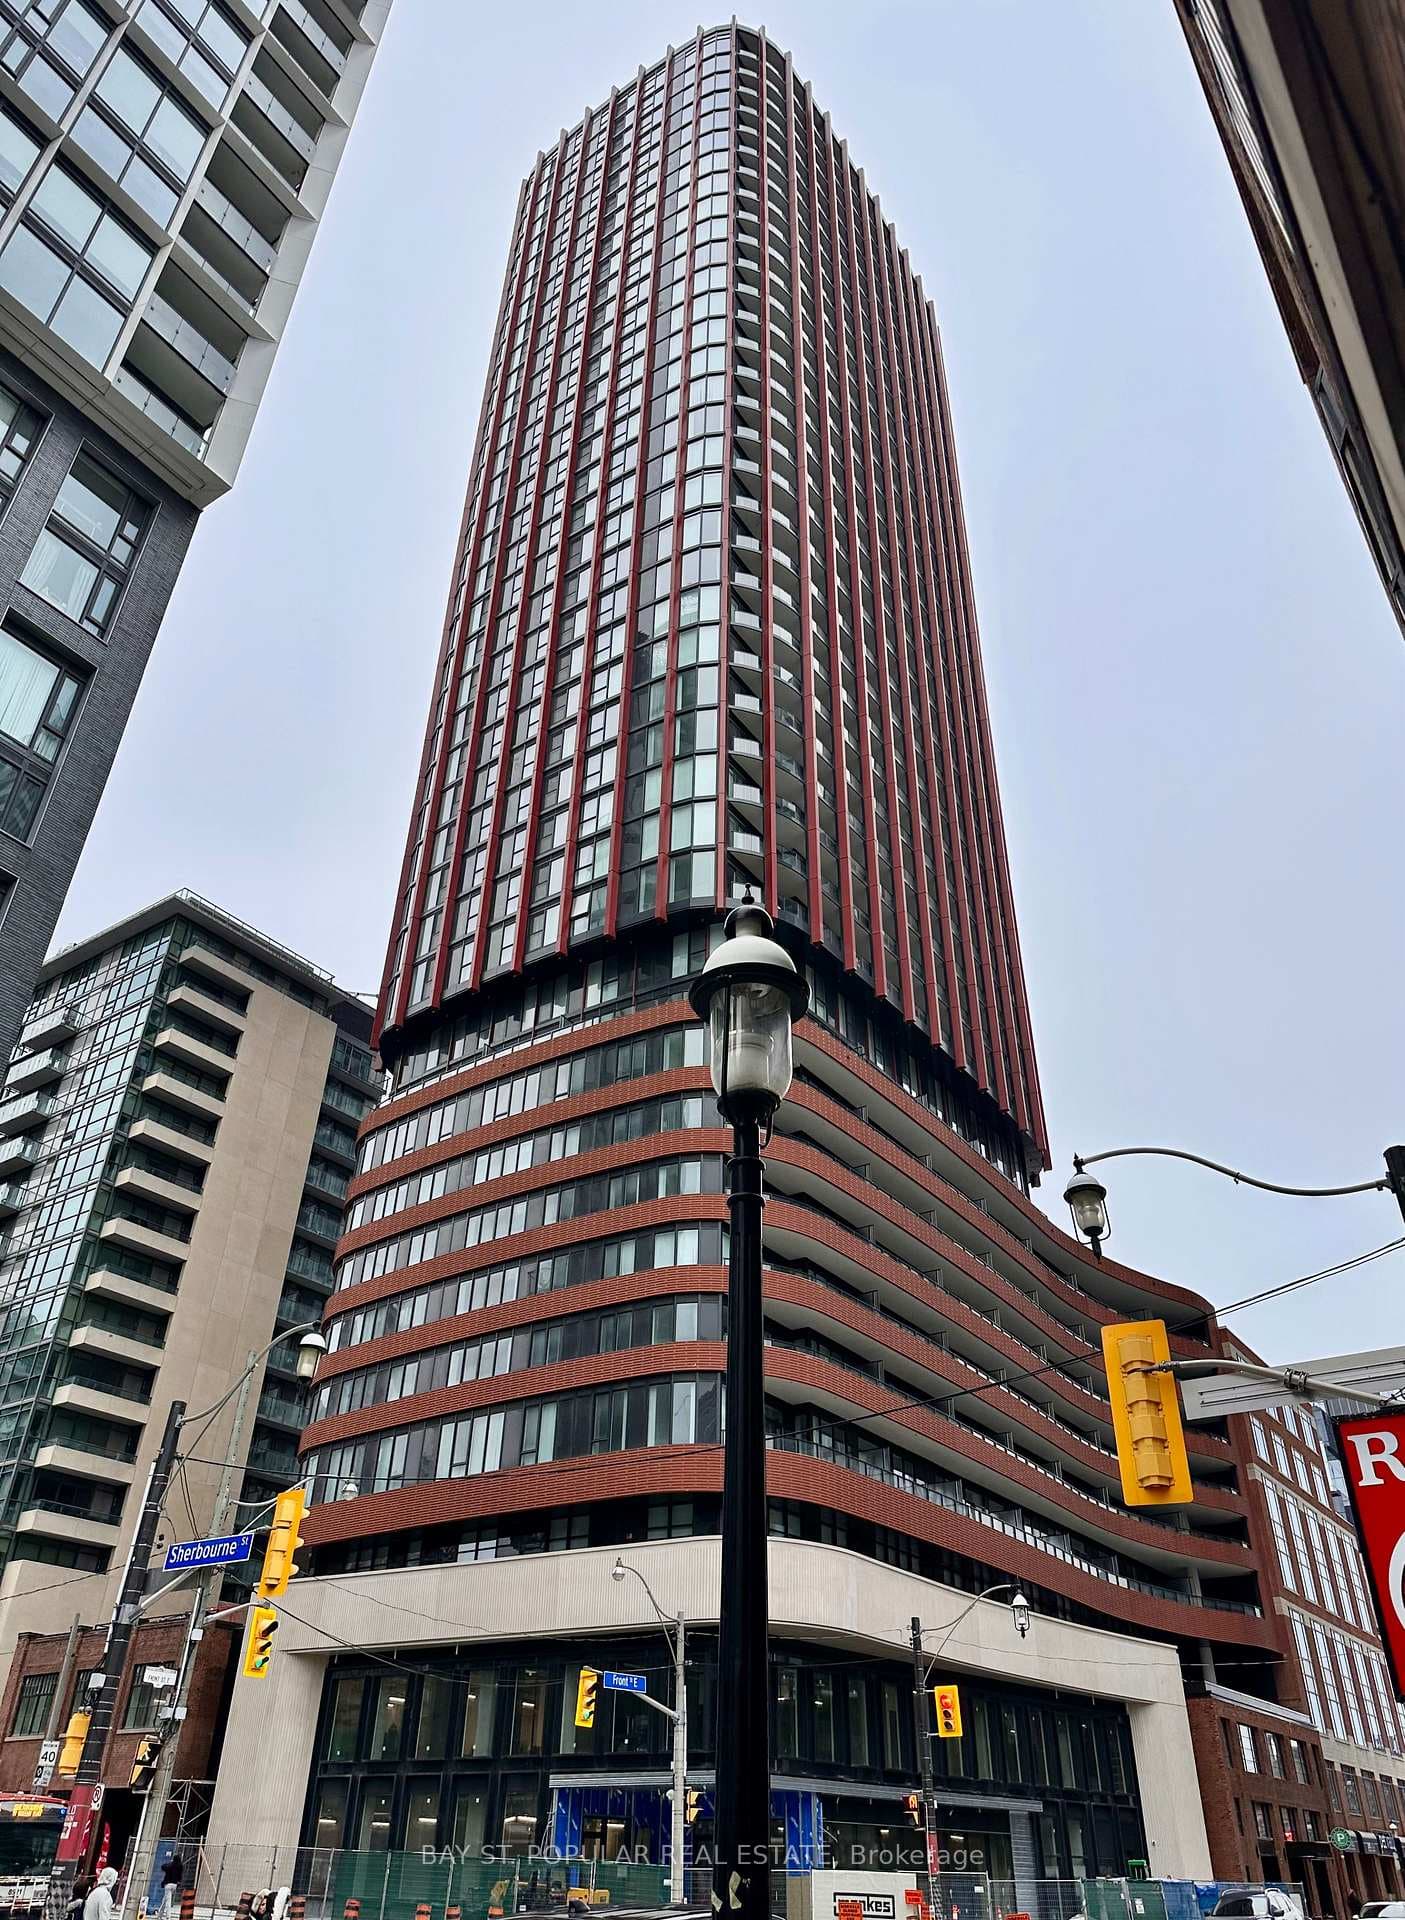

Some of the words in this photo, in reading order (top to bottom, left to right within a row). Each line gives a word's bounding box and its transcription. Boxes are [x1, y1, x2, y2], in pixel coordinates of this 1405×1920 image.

[169, 1541, 237, 1564] Sherbourne
[241, 1536, 249, 1546] St
[612, 1674, 629, 1687] Front
[633, 1677, 639, 1688] E
[41, 1751, 56, 1762] 40
